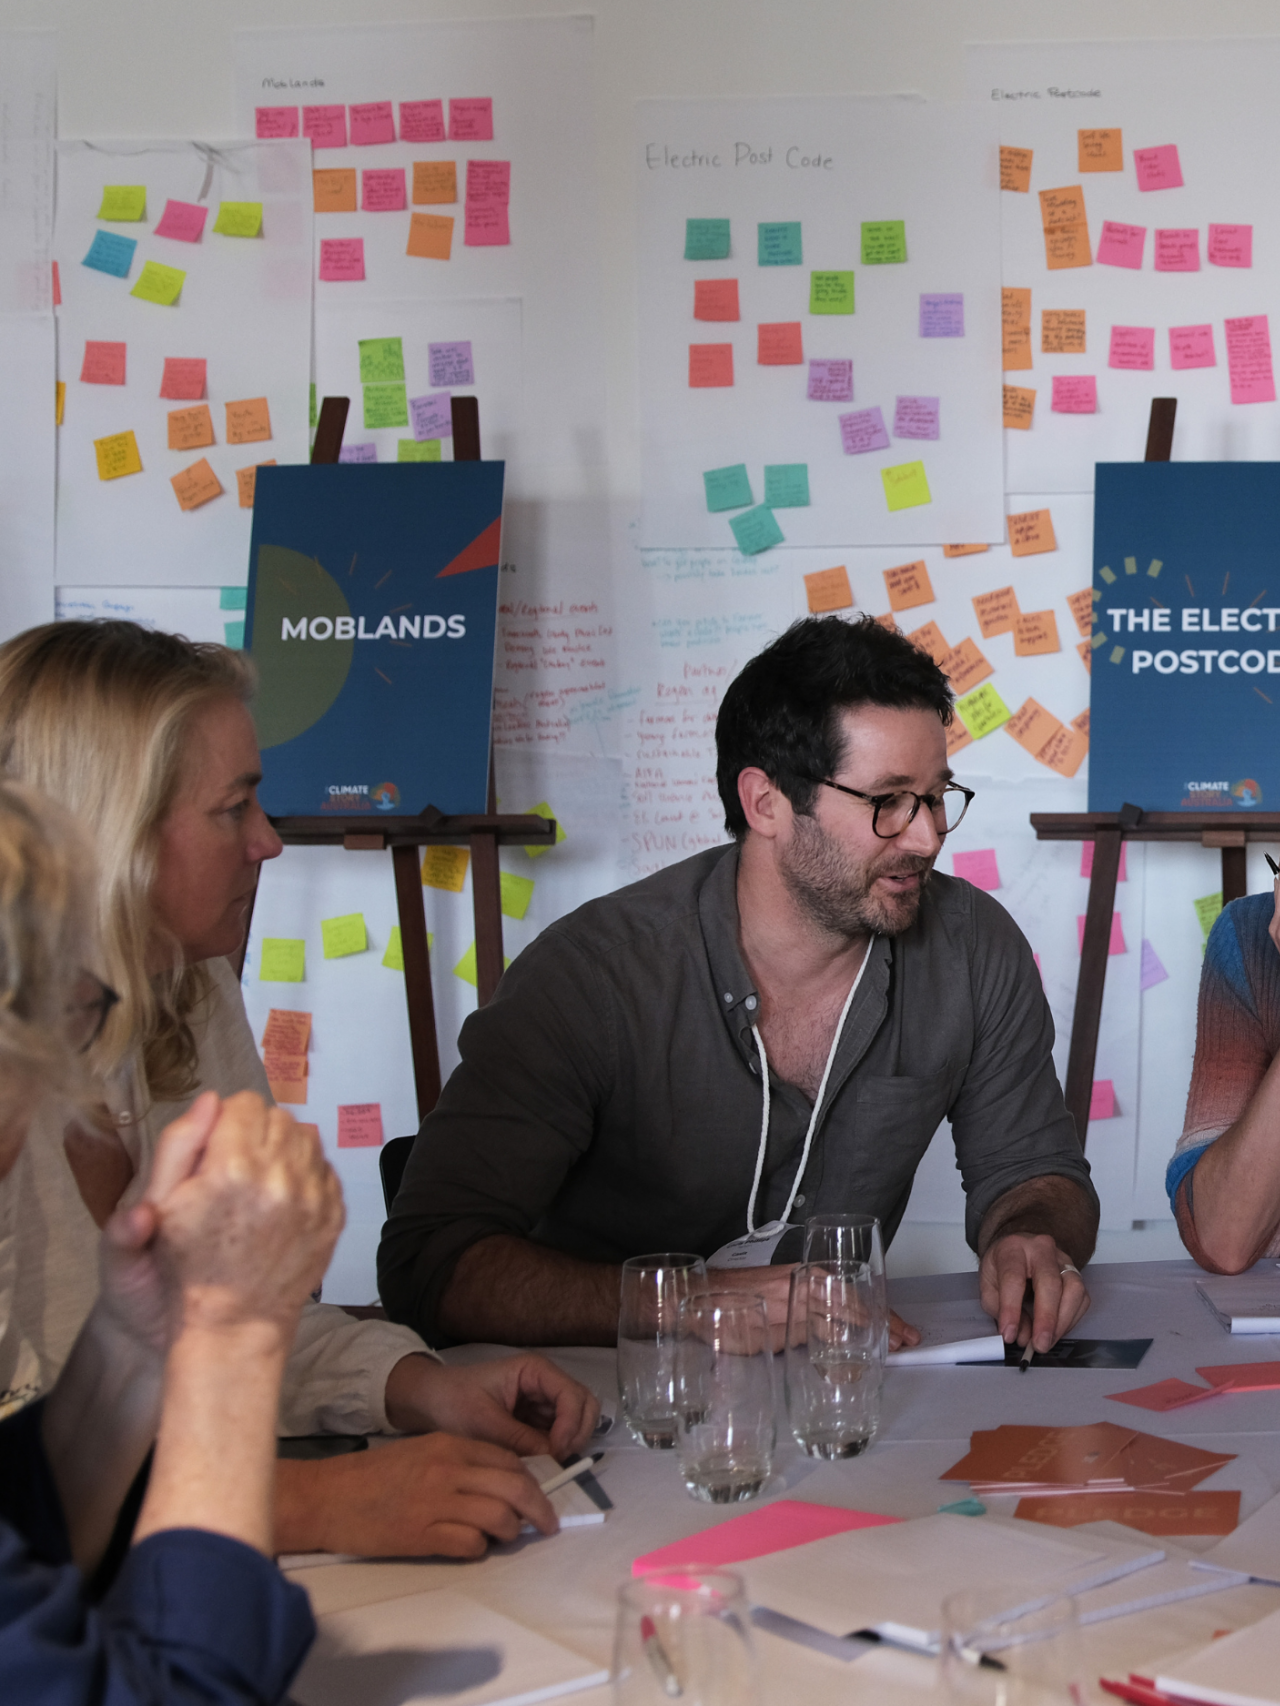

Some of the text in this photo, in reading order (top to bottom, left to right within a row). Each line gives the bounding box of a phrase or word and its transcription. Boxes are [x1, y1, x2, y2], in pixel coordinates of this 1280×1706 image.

[645, 141, 834, 171] Electric Post Code
[281, 613, 467, 643] MOBLANDS
[1107, 608, 1171, 632] THE
[328, 784, 369, 795] CLIMATE
[1187, 780, 1230, 792] CLIMATE
